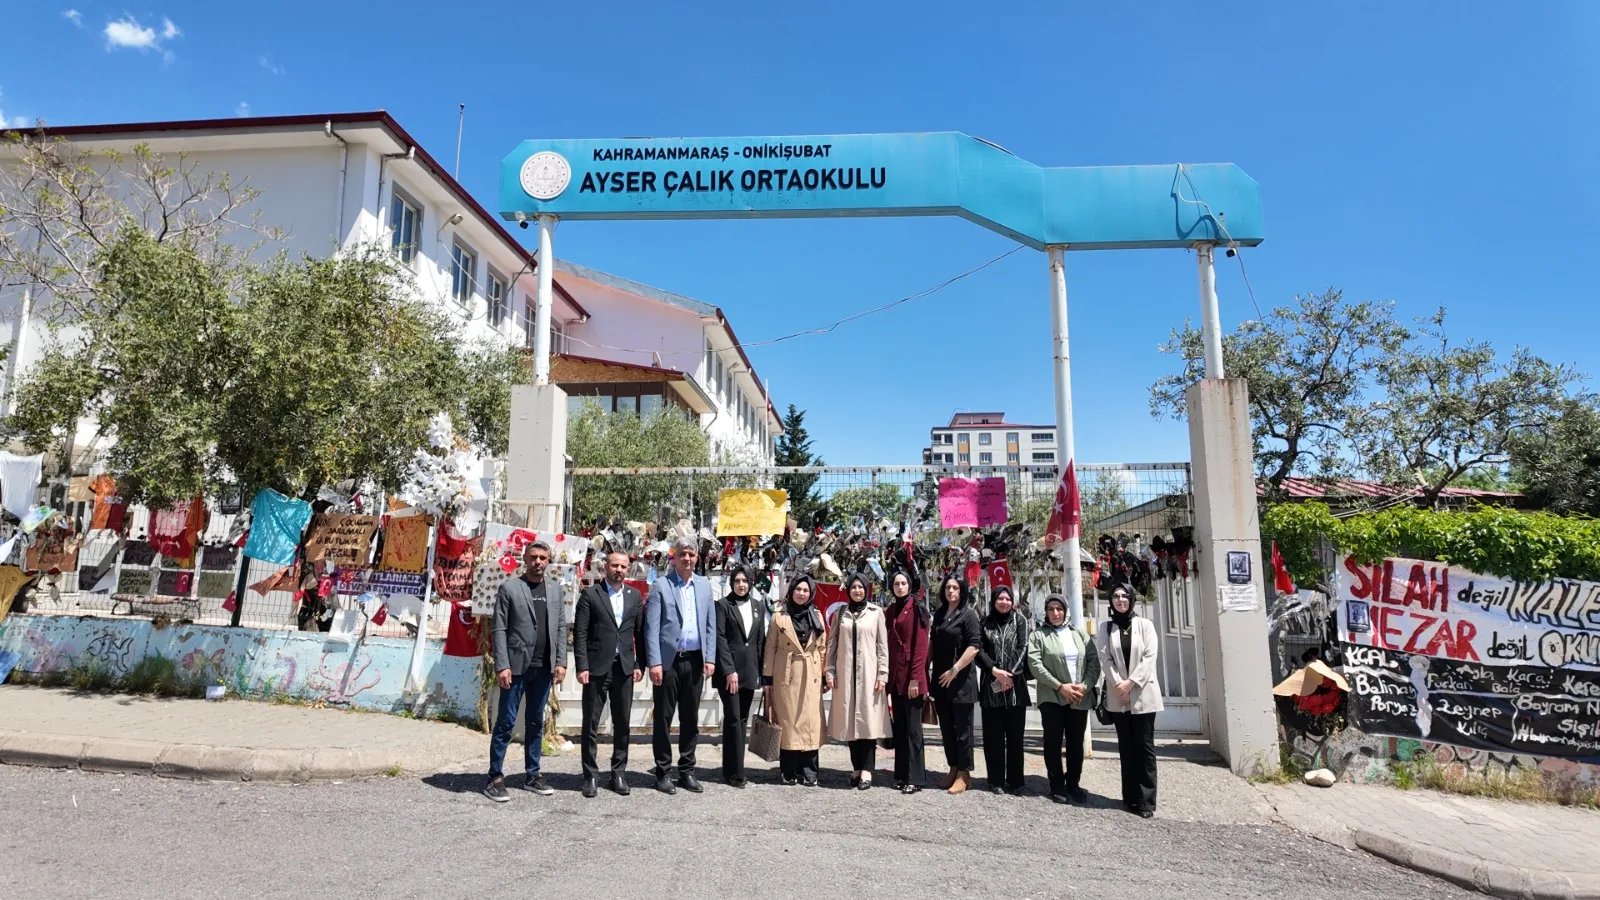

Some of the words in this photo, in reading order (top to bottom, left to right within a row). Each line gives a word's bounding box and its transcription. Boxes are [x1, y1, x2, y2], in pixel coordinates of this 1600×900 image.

[593, 147, 729, 162] KAHRAMANMARAŞ
[743, 143, 832, 161] ONİKİŞUBAT
[580, 171, 657, 193] AYSER
[663, 170, 735, 198] ÇALIK
[741, 167, 886, 192] ORTAOKULU
[1457, 581, 1509, 611] değil
[1436, 699, 1502, 720] Zeynep
[1517, 694, 1580, 716] Bayram
